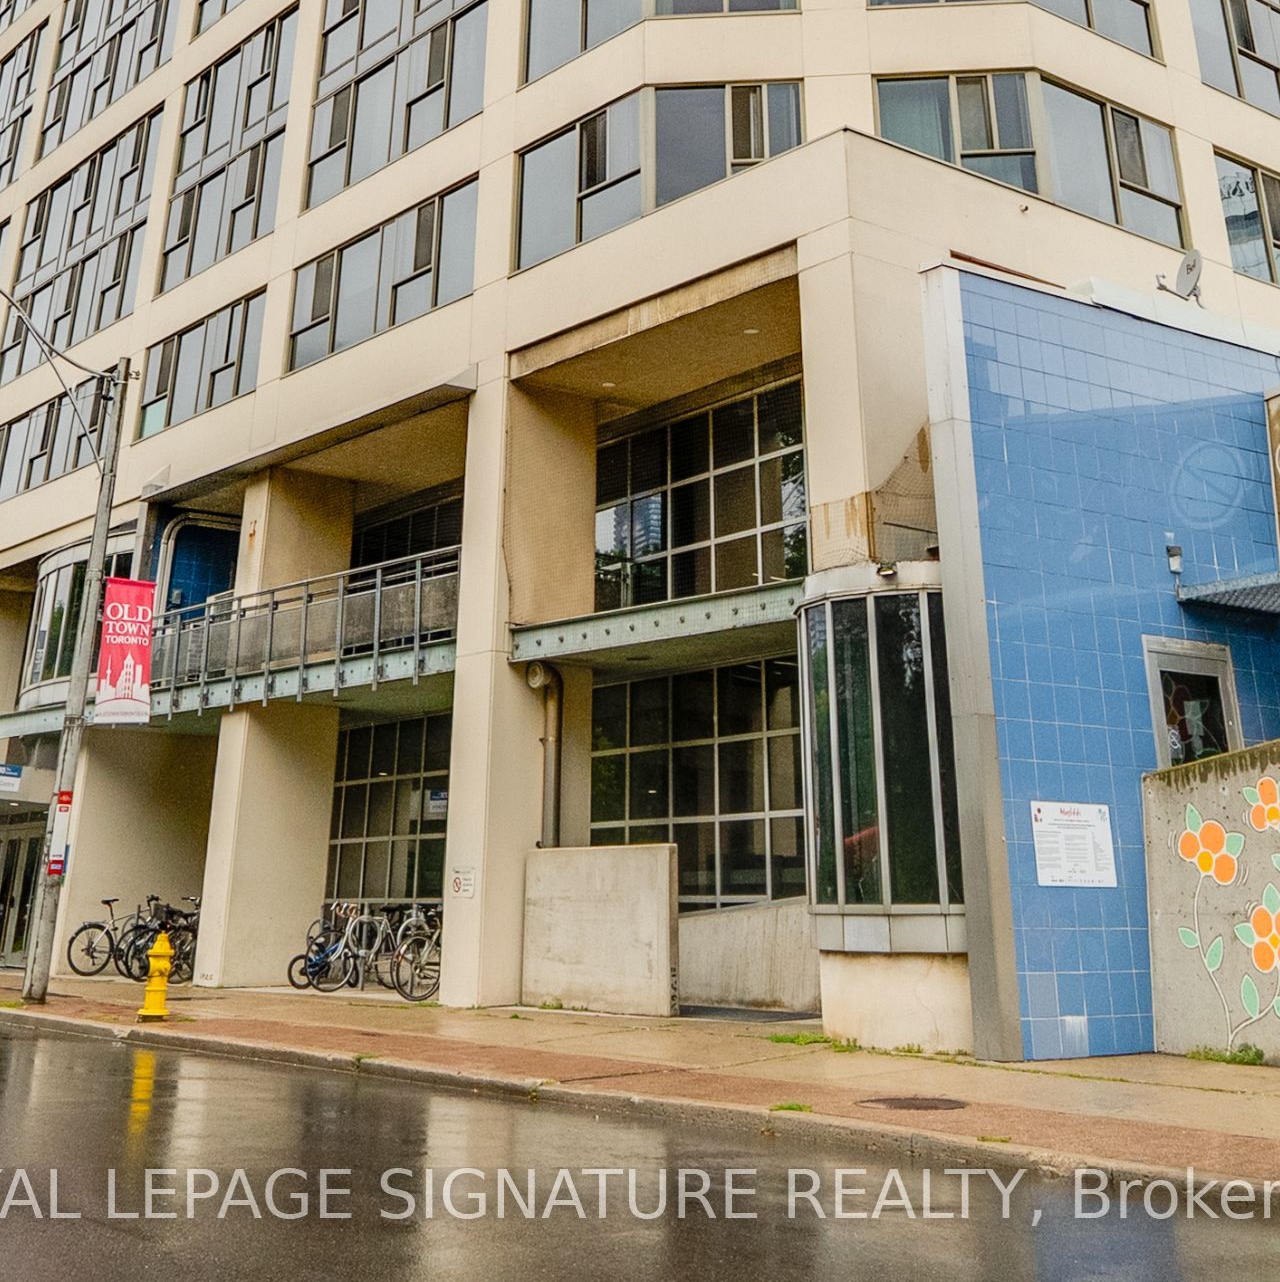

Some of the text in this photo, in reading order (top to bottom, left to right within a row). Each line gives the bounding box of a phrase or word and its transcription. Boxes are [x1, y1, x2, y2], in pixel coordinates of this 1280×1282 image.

[106, 602, 153, 623] OLD
[105, 620, 151, 636] TOWN
[105, 634, 150, 647] TORONTO
